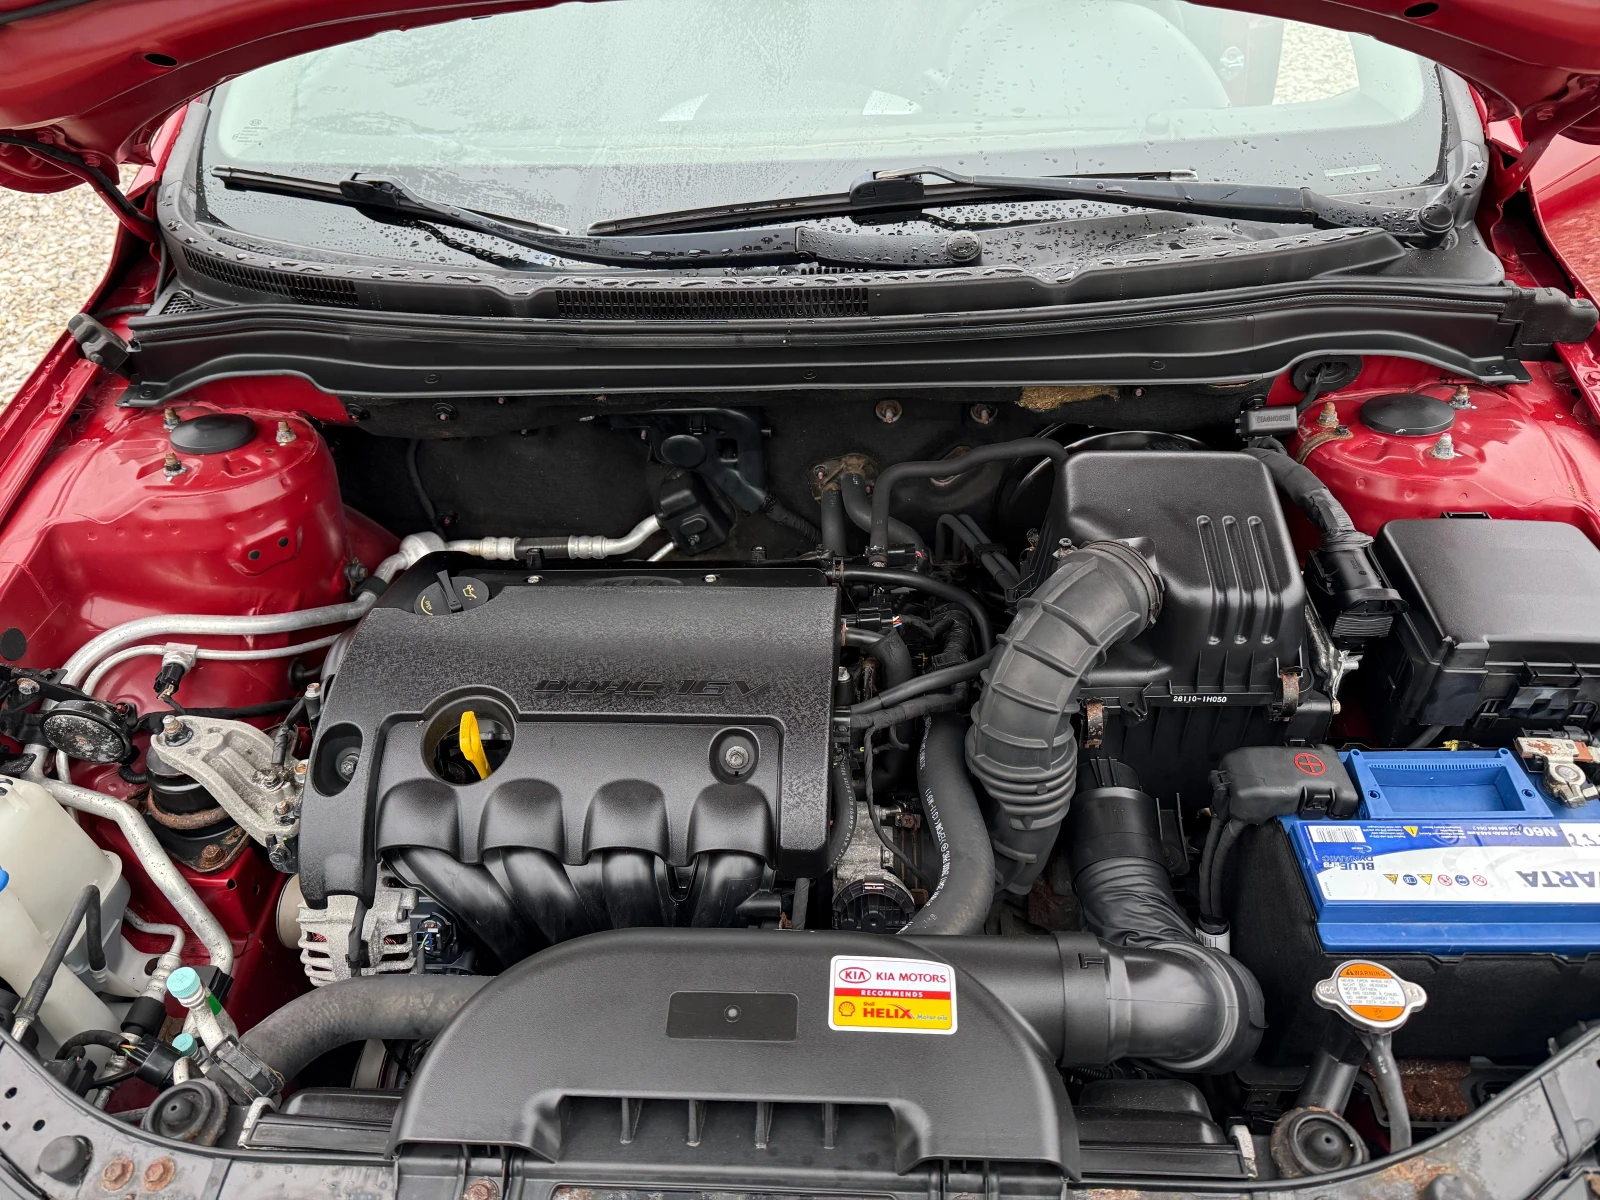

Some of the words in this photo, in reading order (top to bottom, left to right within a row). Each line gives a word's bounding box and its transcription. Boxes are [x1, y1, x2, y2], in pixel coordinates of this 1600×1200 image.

[533, 680, 663, 696] DOHC
[676, 680, 770, 698] 16V
[1523, 826, 1558, 837] N60
[1340, 862, 1374, 870] BLUE
[1515, 870, 1600, 888] ARTA
[844, 970, 866, 980] KIA
[876, 972, 894, 981] KIA
[898, 973, 946, 983] MOTORS
[861, 990, 923, 998] RECOMMENDS
[1319, 986, 1336, 994] HCC
[863, 1006, 913, 1019] HELIX
